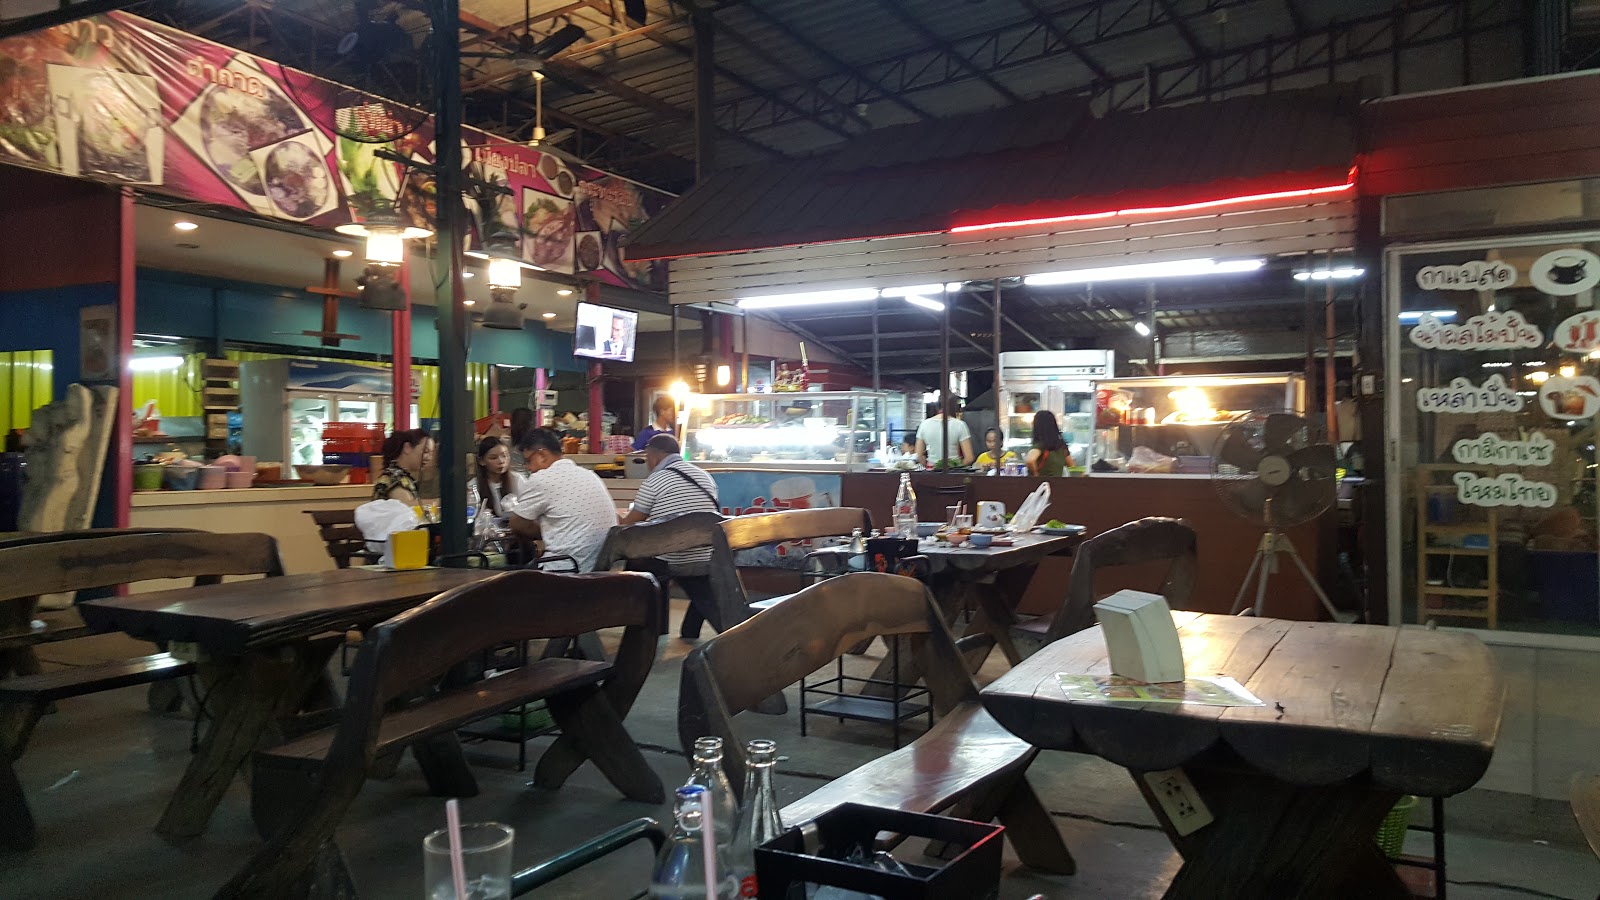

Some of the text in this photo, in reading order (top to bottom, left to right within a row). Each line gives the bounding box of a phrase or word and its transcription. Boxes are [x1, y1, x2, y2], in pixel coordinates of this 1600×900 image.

[1415, 314, 1537, 346] น้ำผลไม้ปั่น
